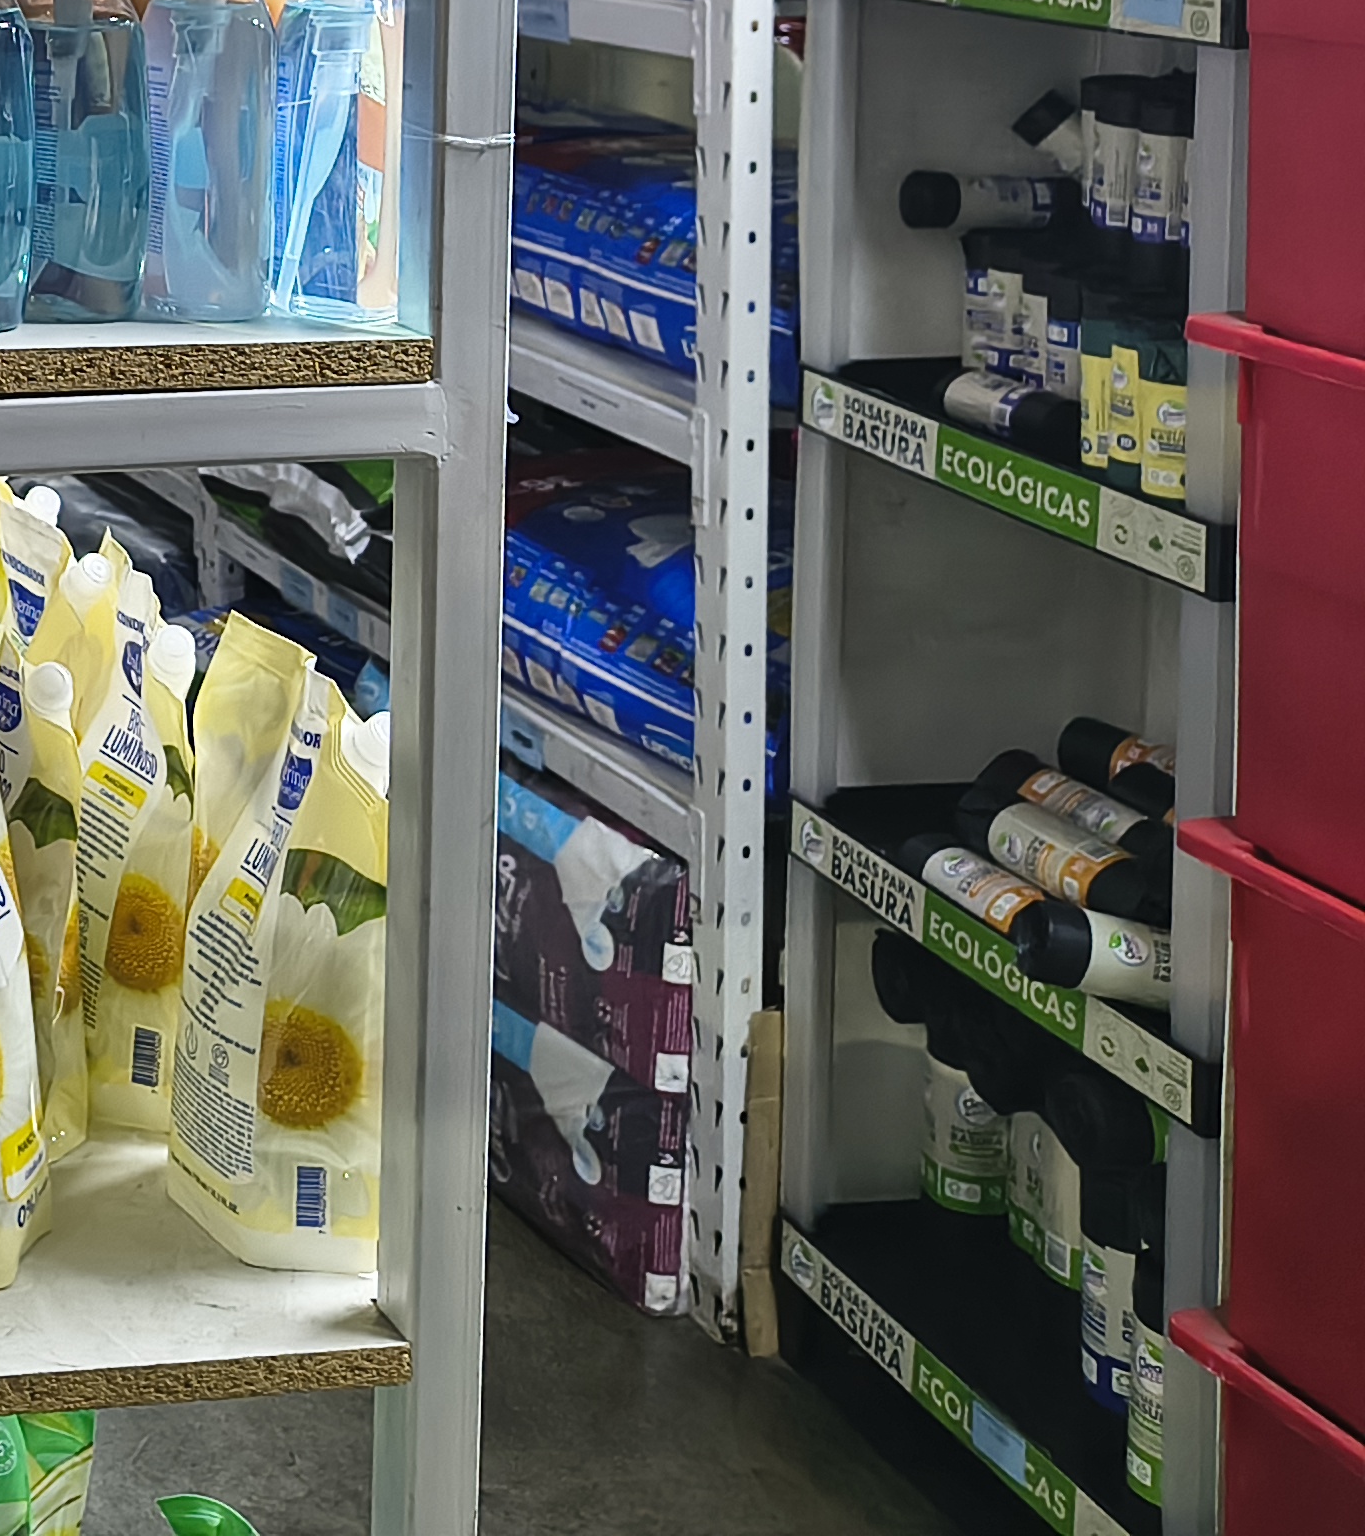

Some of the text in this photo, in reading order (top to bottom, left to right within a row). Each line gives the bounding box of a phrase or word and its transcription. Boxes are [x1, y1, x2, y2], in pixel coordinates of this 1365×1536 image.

[842, 394, 928, 444] BOLSAS PARA
[841, 413, 1091, 528] BASURA ECOLÓGICAS
[832, 835, 917, 904] BOLSAS PARA
[830, 854, 1077, 1031] BASURA ECOLÓGICAS
[820, 1263, 905, 1351] BOLSAS PARA
[819, 1282, 1068, 1522] BASURA ECOLCAS
